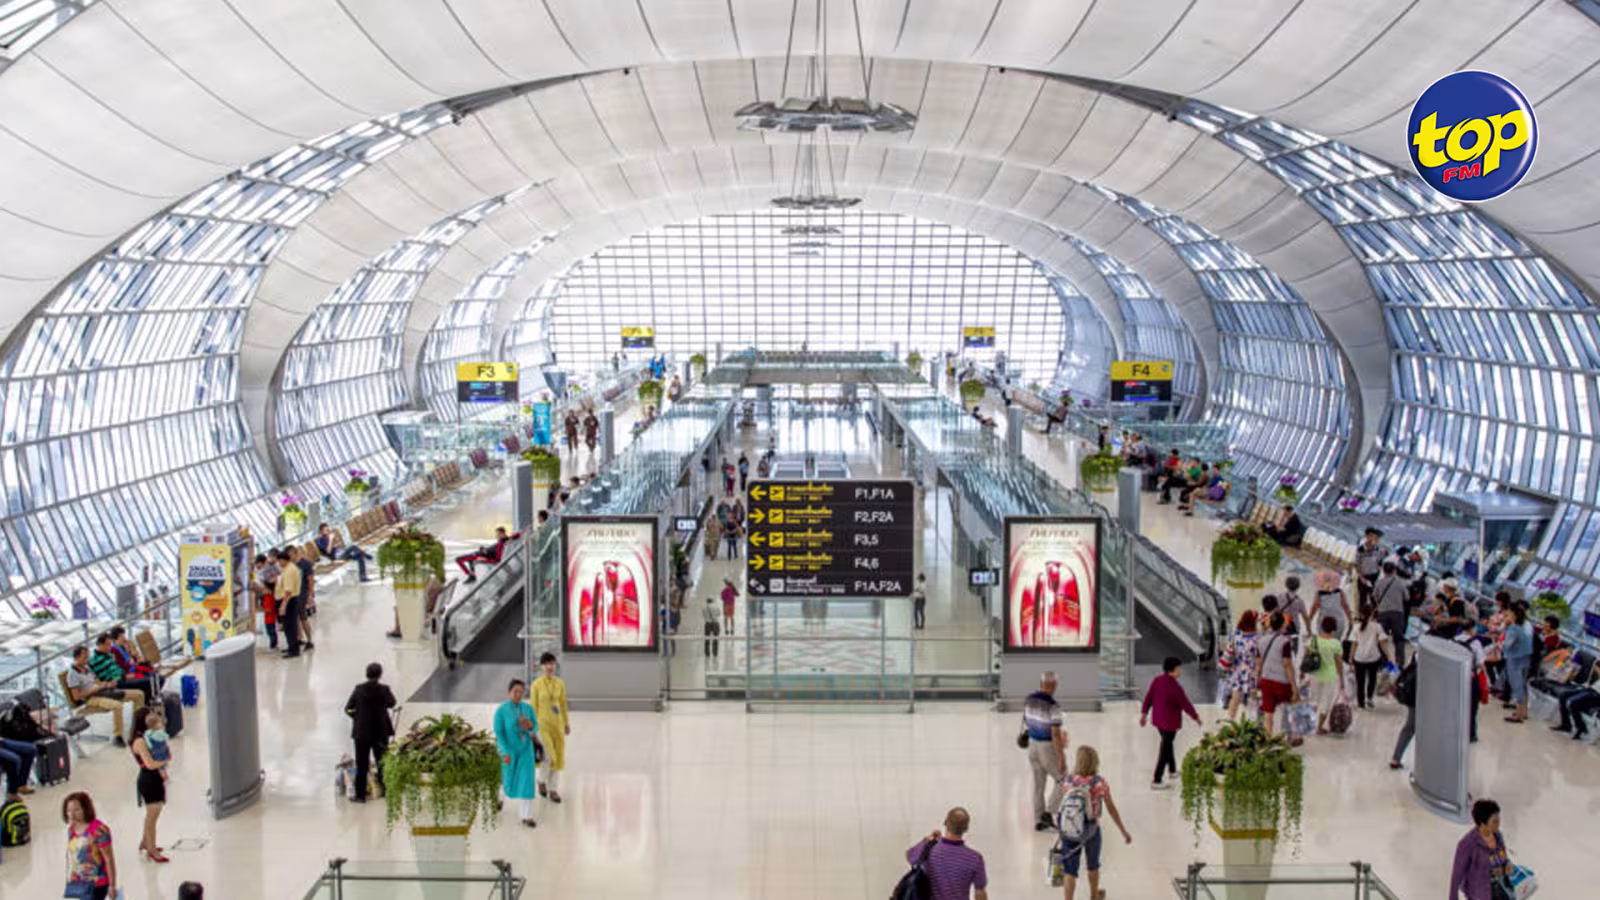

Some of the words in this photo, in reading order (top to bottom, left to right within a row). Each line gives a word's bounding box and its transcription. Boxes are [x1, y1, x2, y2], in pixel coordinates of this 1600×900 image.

[476, 365, 496, 378] F3
[1131, 363, 1151, 377] F4
[854, 487, 895, 500] F1,F1A
[854, 511, 895, 523] F2,F2A
[854, 534, 880, 546] F3,5
[854, 557, 880, 570] F4,6
[854, 580, 902, 592] F1A,F2A
